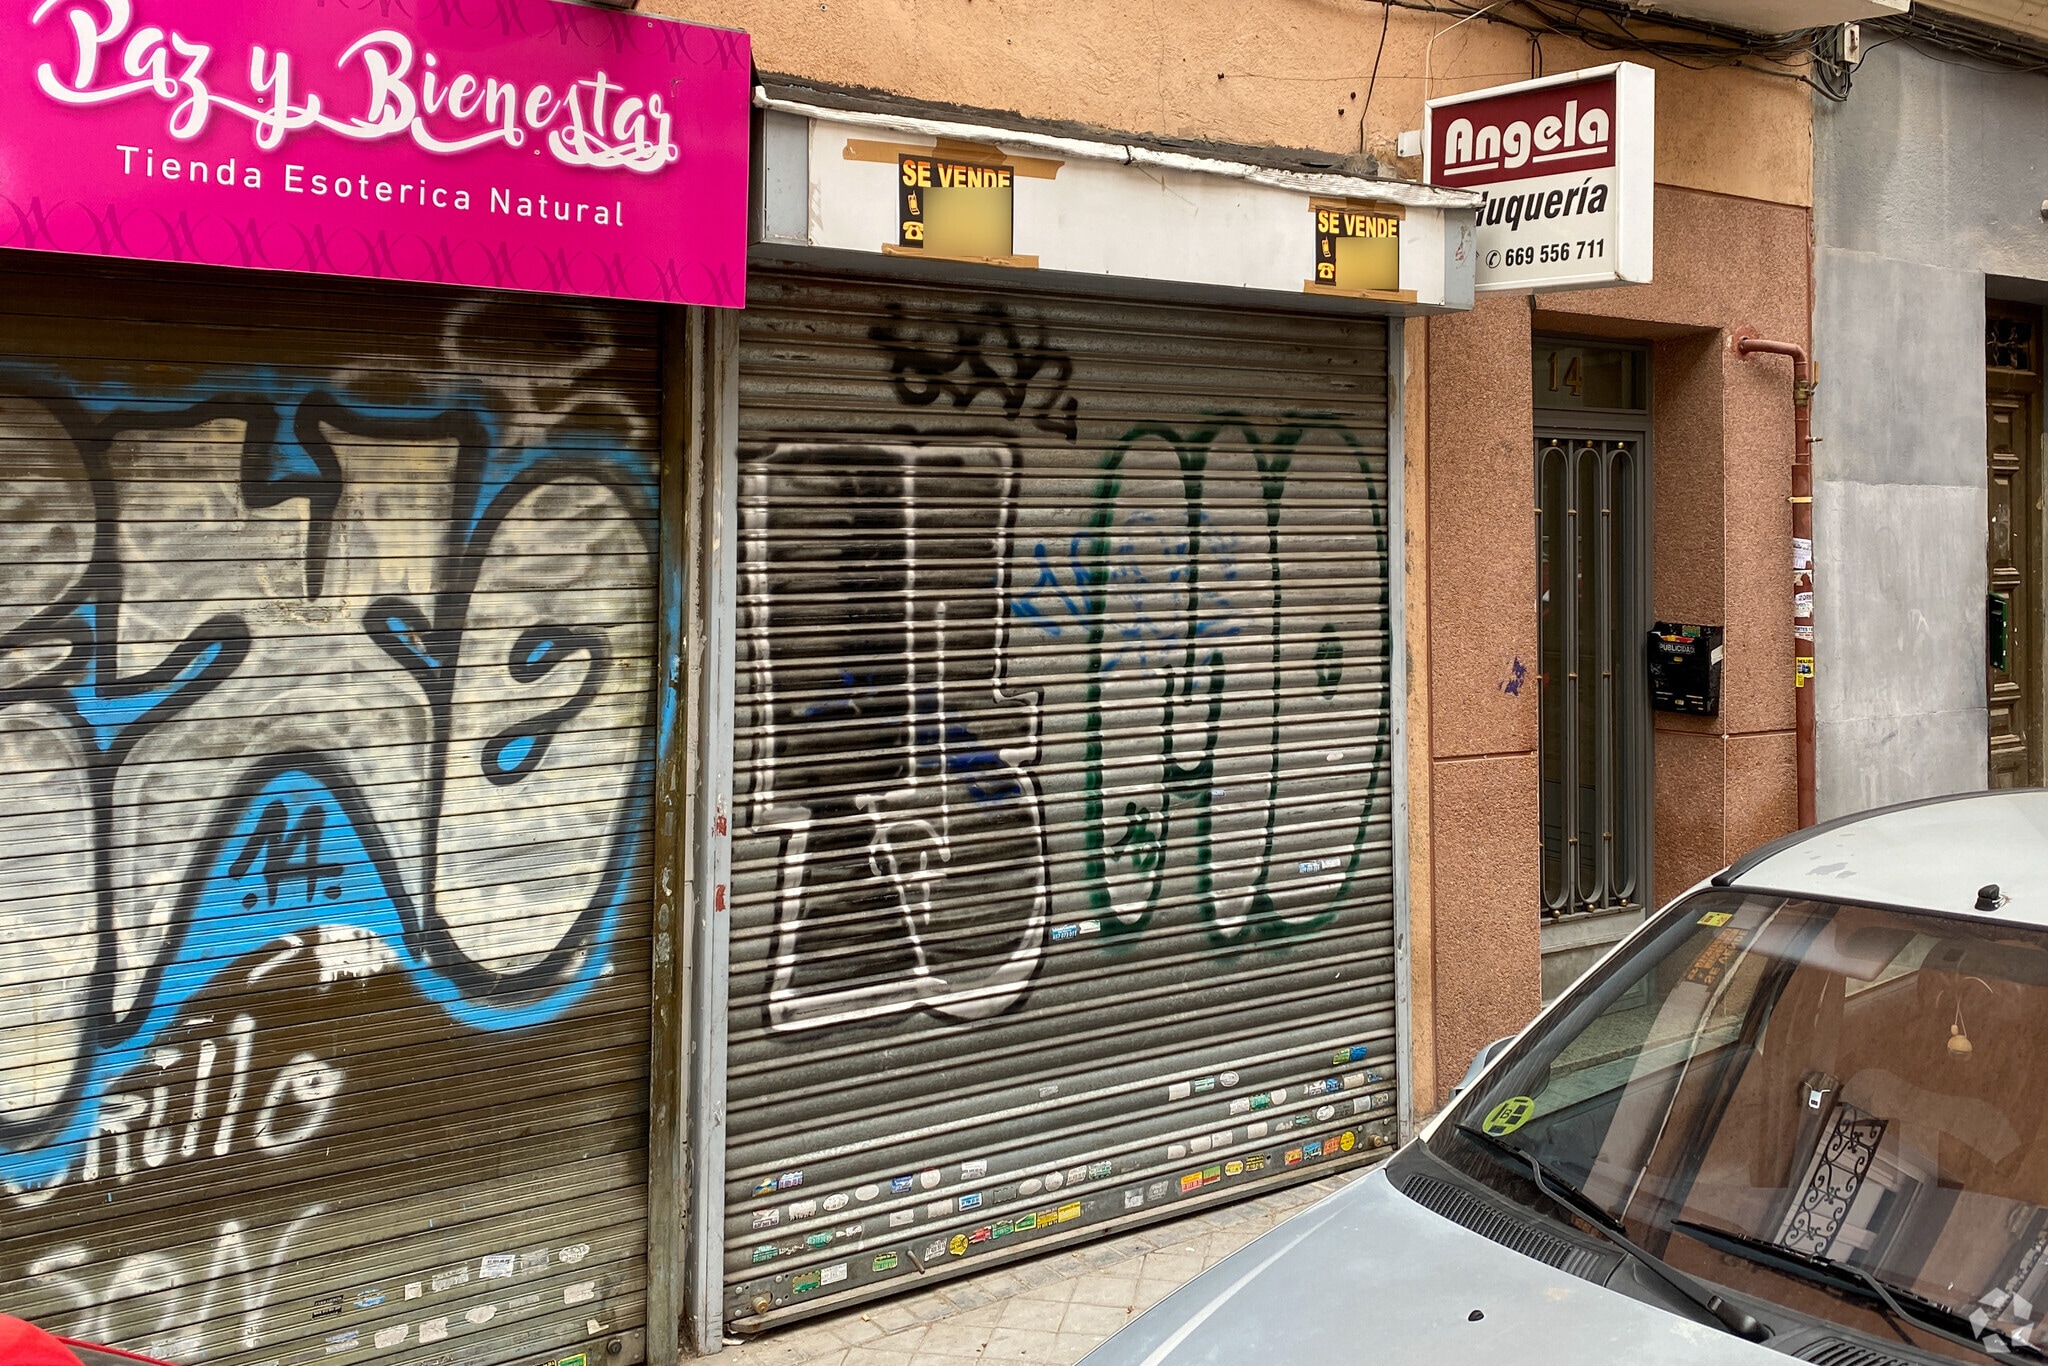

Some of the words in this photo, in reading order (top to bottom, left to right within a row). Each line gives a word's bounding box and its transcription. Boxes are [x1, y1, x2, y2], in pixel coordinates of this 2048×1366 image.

[32, 0, 210, 140] Paz
[250, 45, 324, 150] y
[338, 29, 679, 173] Bienestar
[1444, 100, 1610, 170] Angela
[116, 144, 263, 190] Tienda
[285, 165, 471, 212] Esoterica
[490, 187, 625, 228] Natural
[902, 159, 932, 188] SE
[938, 162, 1011, 188] VENDE
[1475, 176, 1609, 232] luquería
[1318, 209, 1340, 235] SE
[1344, 214, 1398, 239] VENDE
[1505, 244, 1534, 267] 669
[1540, 242, 1571, 263] 556
[1576, 238, 1605, 260] 711
[1548, 351, 1583, 397] 14
[1659, 643, 1695, 653] PUBLICIDAD
[1500, 1108, 1513, 1119] B
